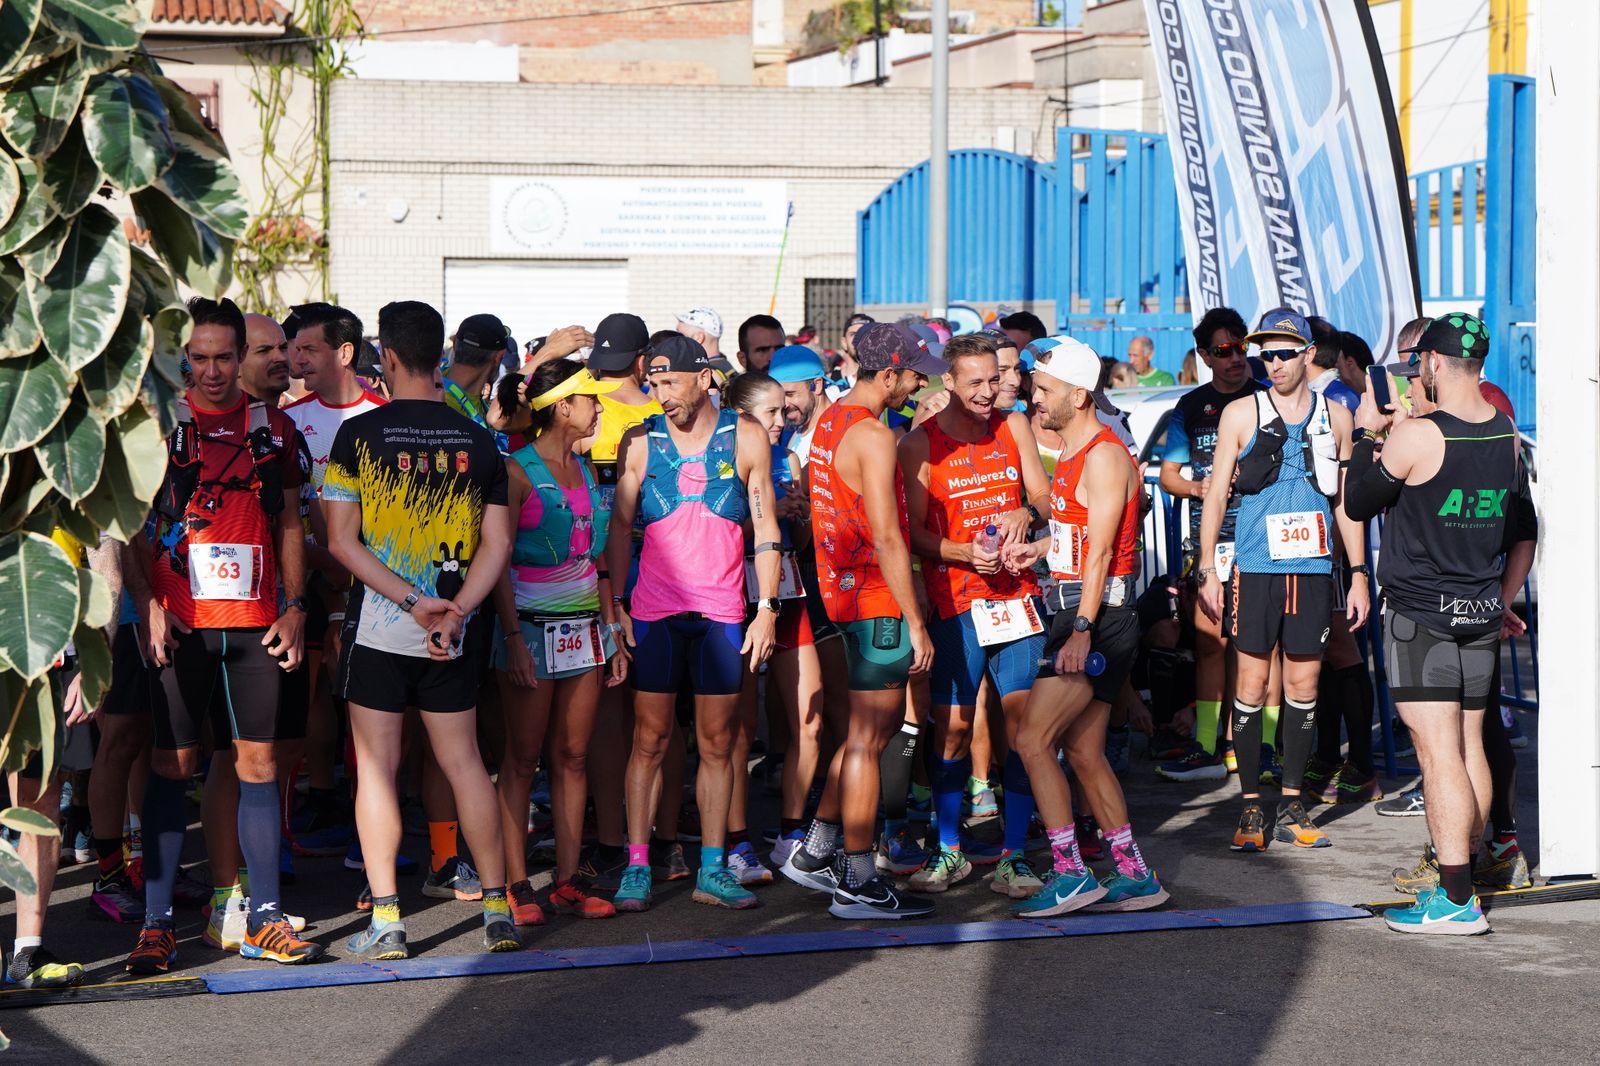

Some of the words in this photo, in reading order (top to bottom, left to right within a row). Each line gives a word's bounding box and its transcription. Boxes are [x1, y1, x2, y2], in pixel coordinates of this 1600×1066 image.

[409, 427, 419, 435] los
[416, 436, 426, 444] los
[948, 471, 1006, 490] Movijerez
[1437, 488, 1508, 519] AREX
[963, 518, 979, 528] SG
[1281, 527, 1309, 543] 340
[991, 610, 1010, 627] 54
[557, 635, 582, 653] 346
